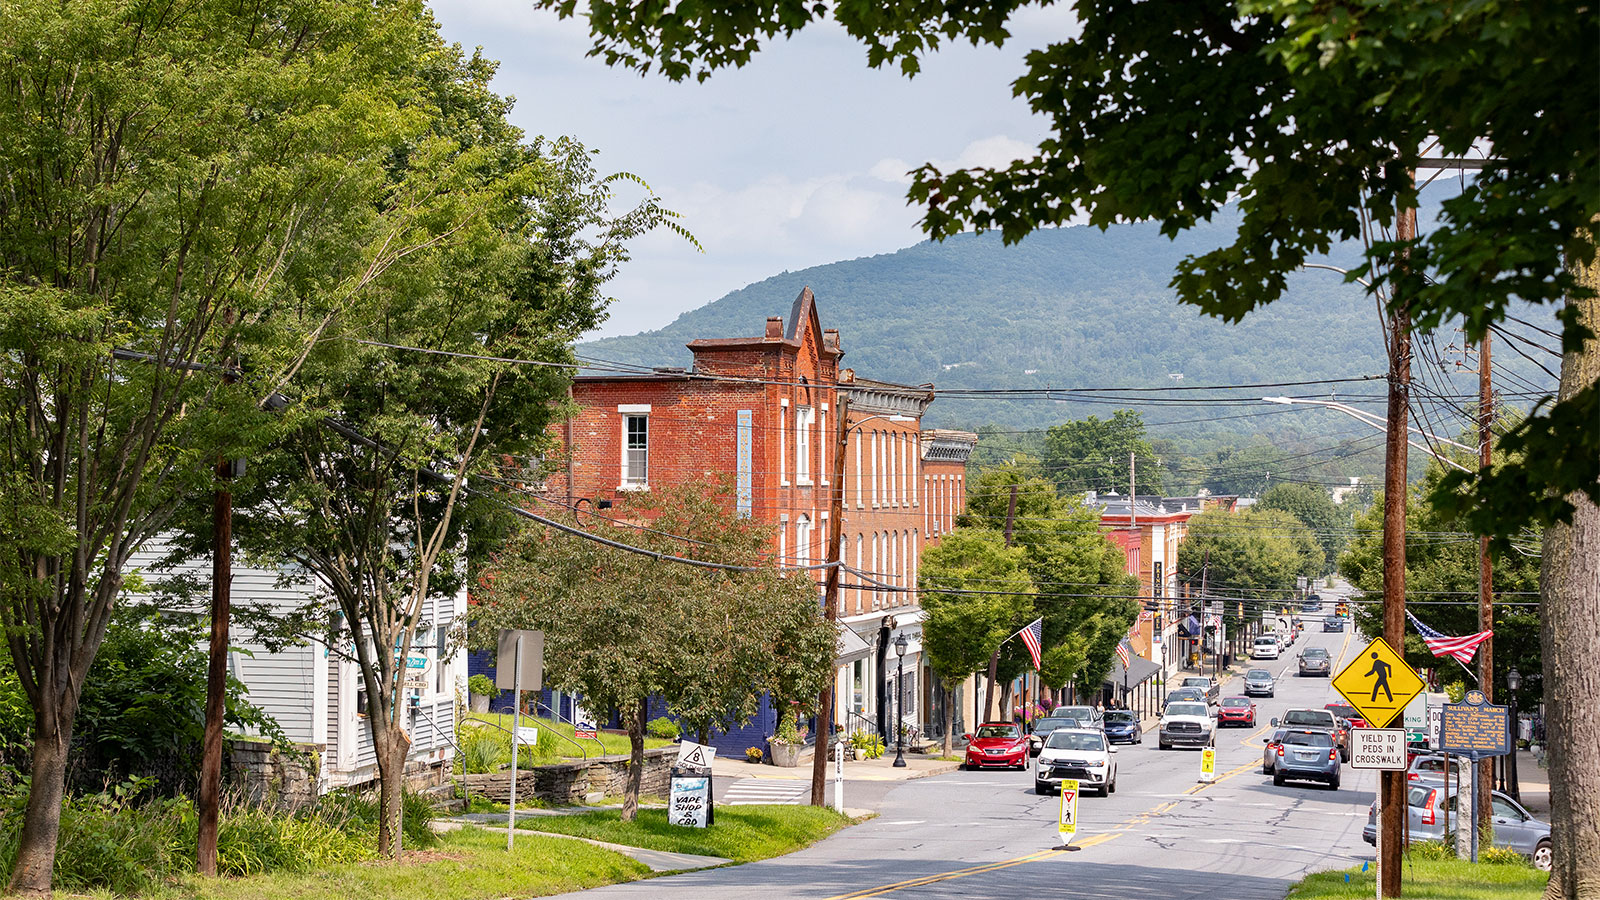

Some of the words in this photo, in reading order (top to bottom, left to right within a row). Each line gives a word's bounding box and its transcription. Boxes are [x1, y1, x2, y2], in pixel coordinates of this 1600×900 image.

[1360, 735, 1383, 743] YIELD
[1387, 735, 1397, 743] TO
[1363, 745, 1383, 753] PEDS
[1387, 745, 1394, 753] IN
[693, 752, 700, 762] 8
[1355, 755, 1401, 764] CROSSWALK
[676, 796, 701, 804] VAPE
[678, 818, 698, 826] CBD
